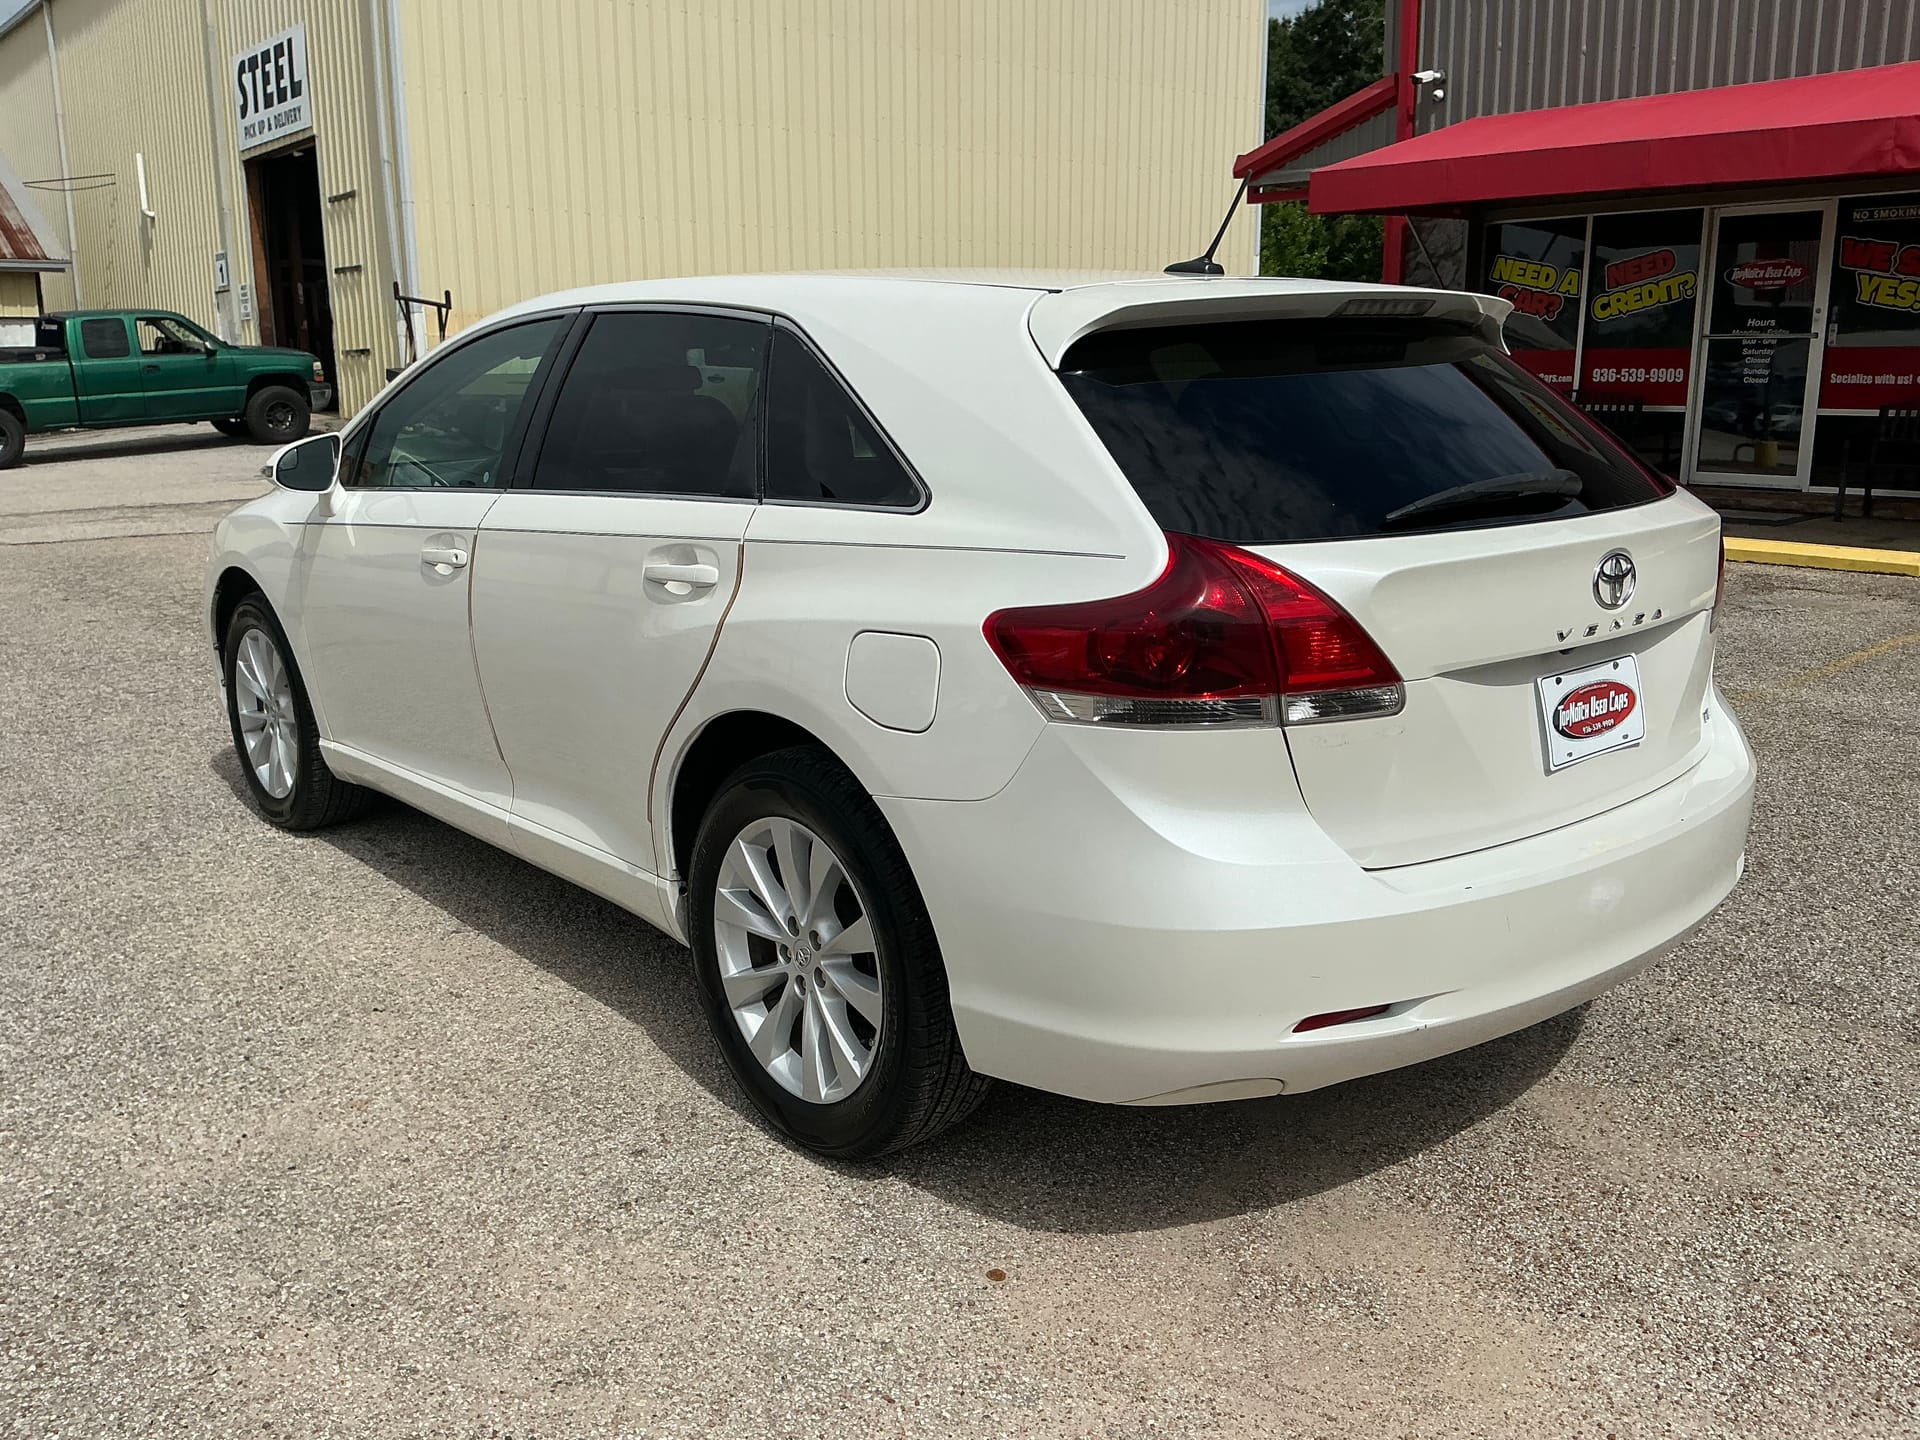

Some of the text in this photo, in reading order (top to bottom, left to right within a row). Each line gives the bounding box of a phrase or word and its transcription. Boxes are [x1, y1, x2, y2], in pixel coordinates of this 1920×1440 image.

[237, 37, 302, 120] STEEL
[244, 105, 302, 140] PICK UP & DELIVERY
[1853, 211, 1869, 220] NO
[1842, 238, 1897, 273] WE
[219, 263, 225, 284] 1
[1491, 256, 1580, 296] NEED A
[1606, 250, 1675, 290] NEED
[1499, 285, 1562, 319] CAR?
[1593, 272, 1697, 319] CREDIT?
[1747, 318, 1776, 327] Hours
[1742, 347, 1775, 356] Saturday
[1745, 356, 1770, 364] Closed
[1592, 368, 1684, 383] 936-539-9909
[1743, 367, 1770, 376] Sunday
[1743, 376, 1769, 384] Closed
[1830, 373, 1913, 384] Socialize with us!
[1556, 608, 1664, 643] VENZA
